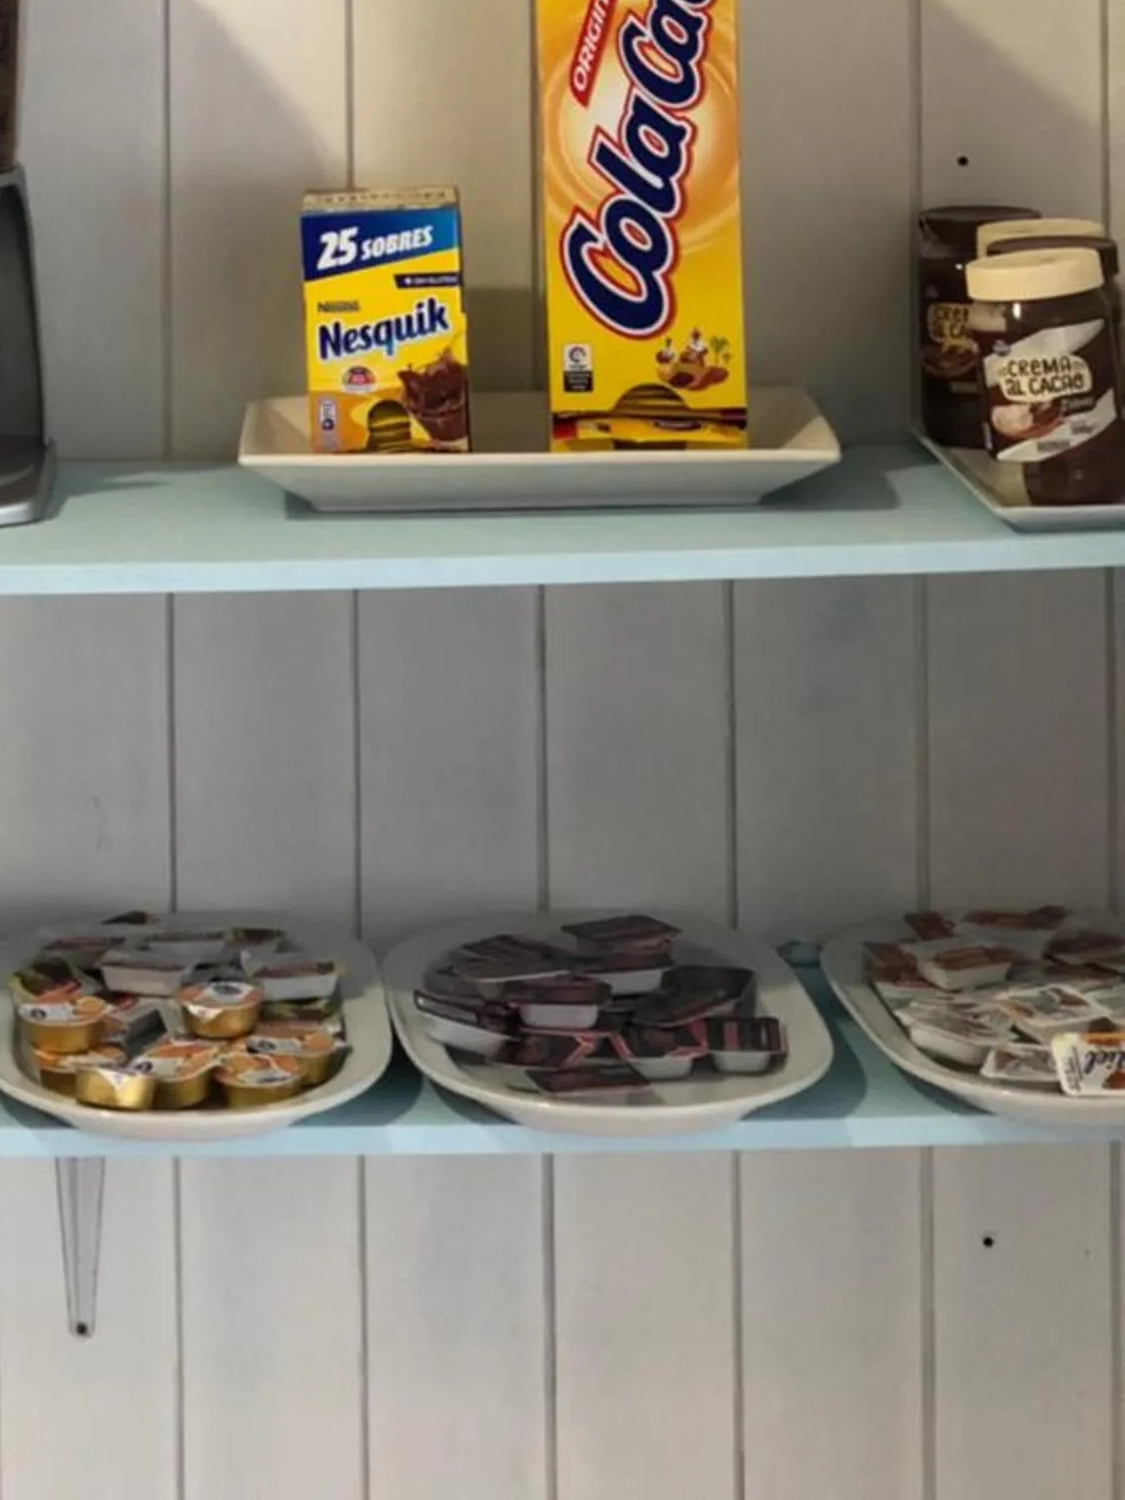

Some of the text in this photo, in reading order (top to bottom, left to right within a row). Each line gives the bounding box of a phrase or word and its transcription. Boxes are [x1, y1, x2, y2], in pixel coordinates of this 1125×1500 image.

[316, 224, 434, 271] 25 SOBRES
[318, 297, 450, 360] Nesquik
[1028, 371, 1084, 396] CACAO
